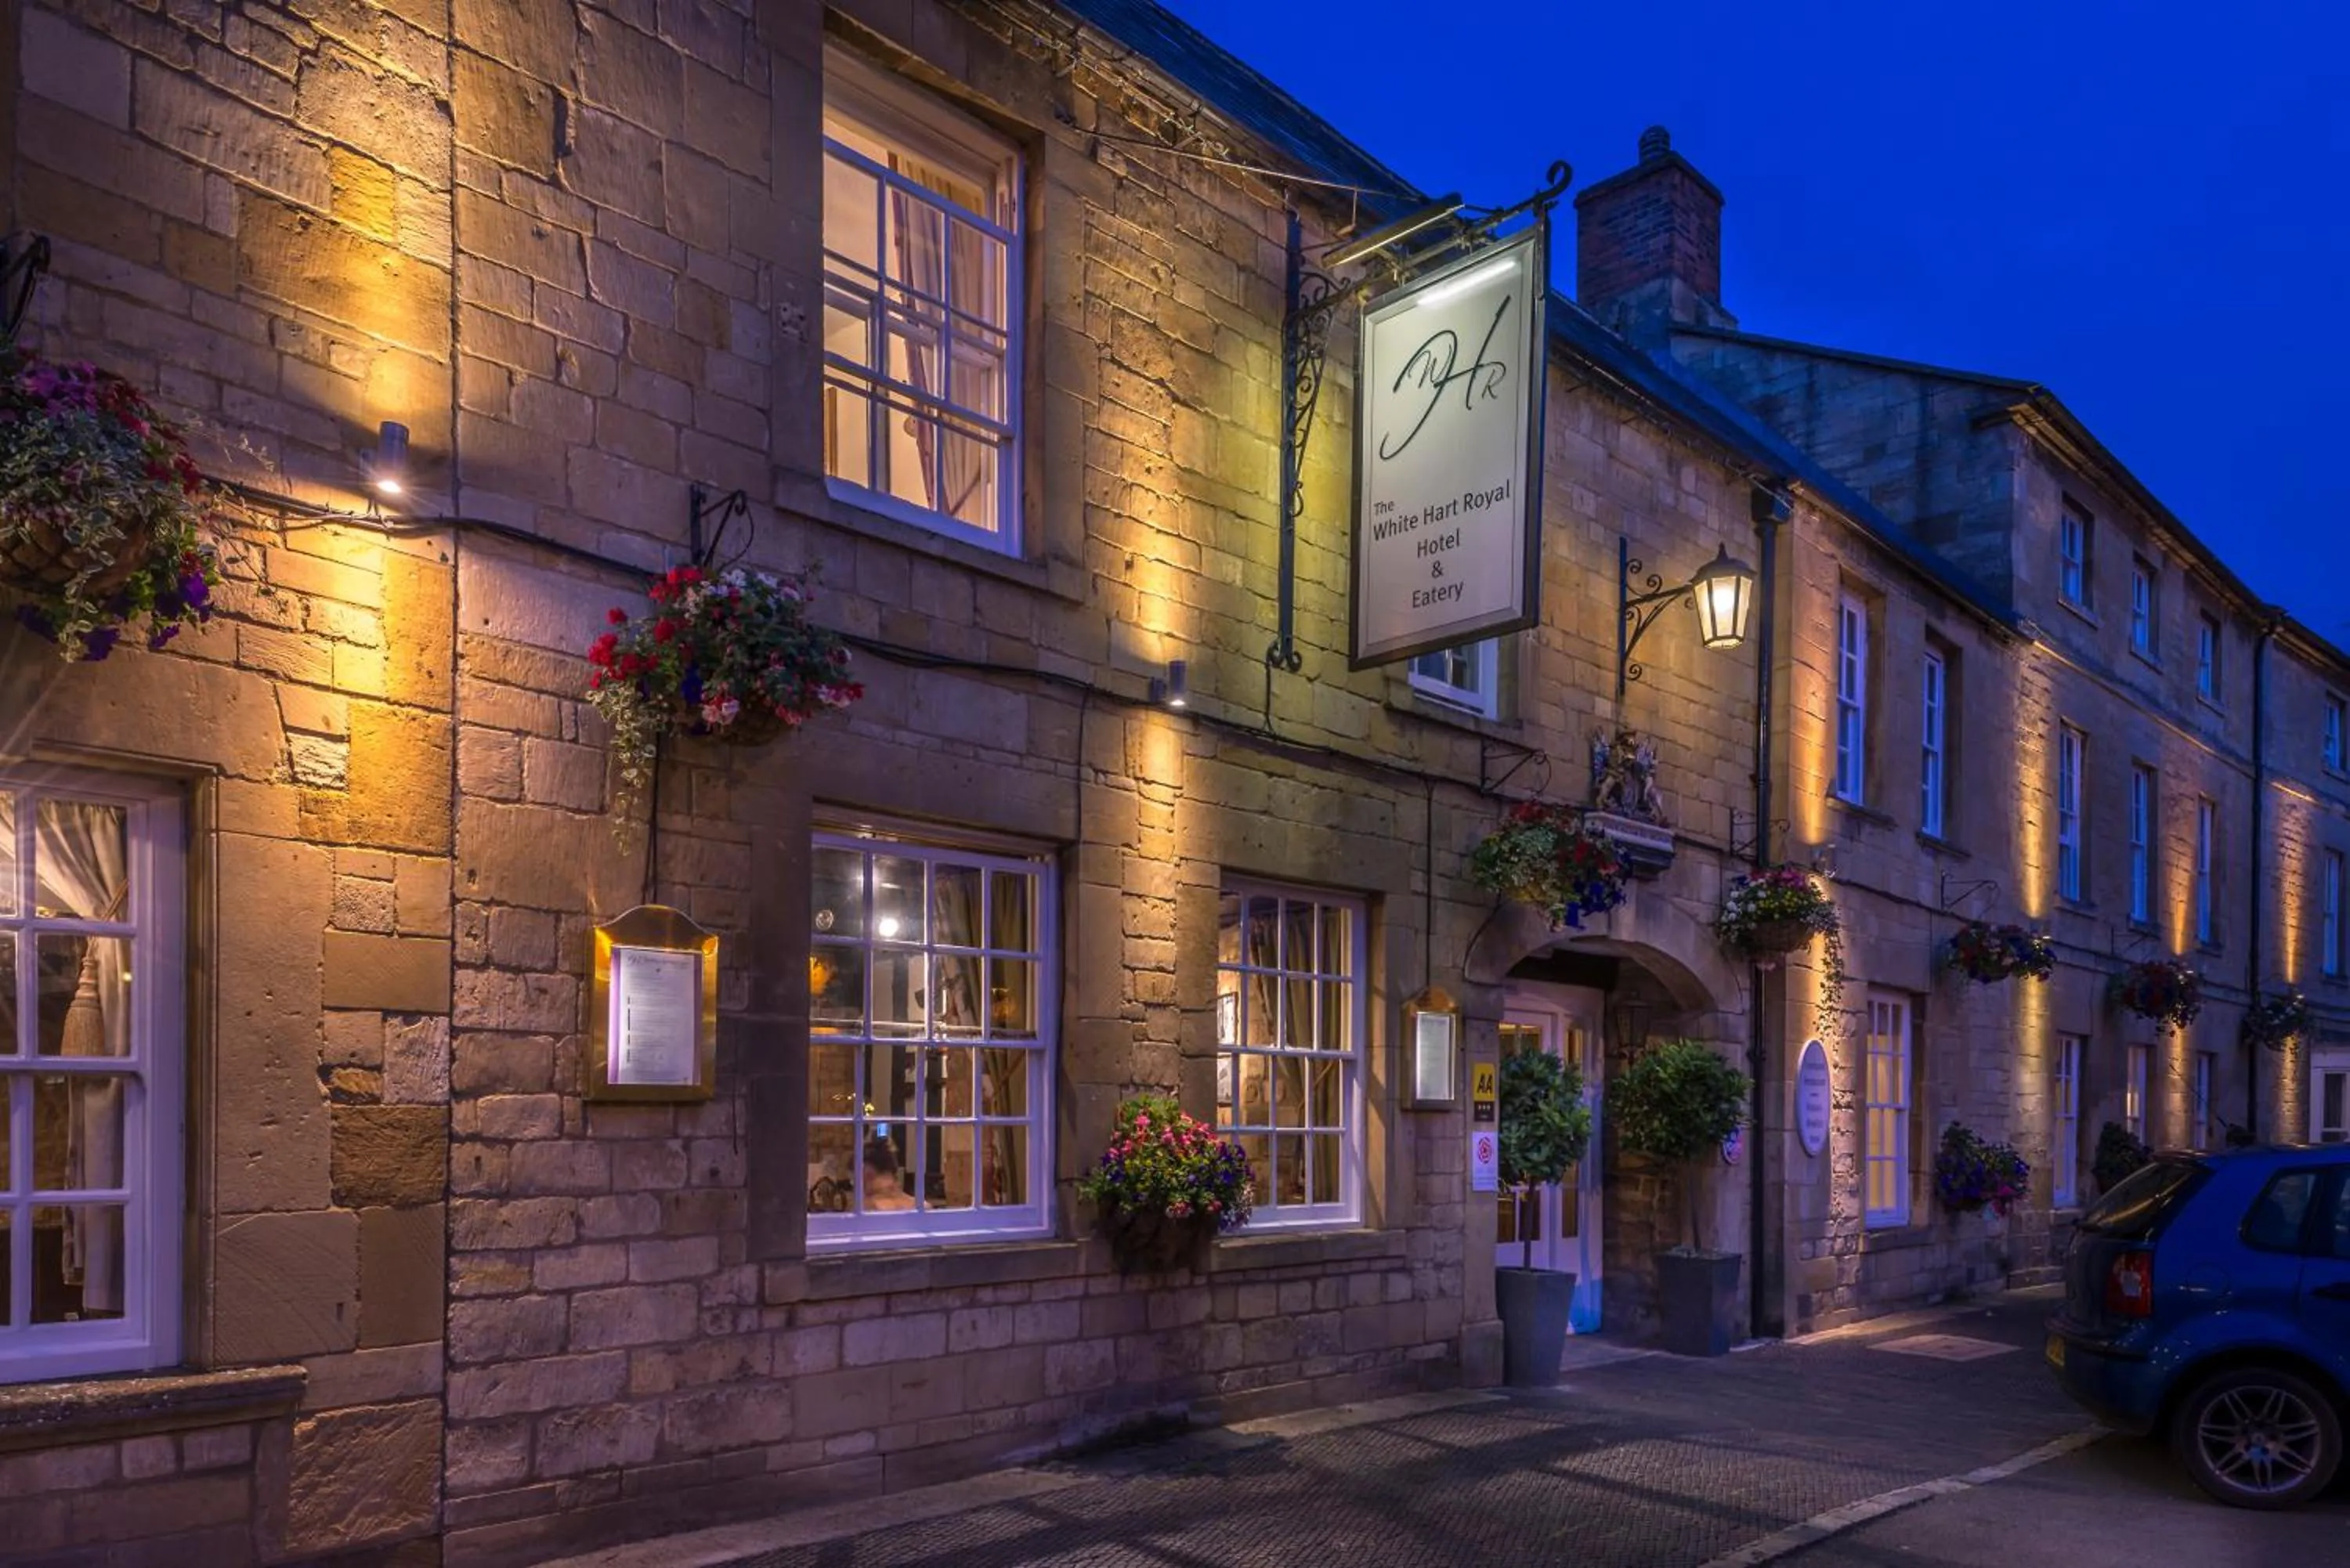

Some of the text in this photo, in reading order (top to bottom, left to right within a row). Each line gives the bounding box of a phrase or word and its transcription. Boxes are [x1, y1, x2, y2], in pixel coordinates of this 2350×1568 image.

[1373, 479, 1510, 542] White Hart Royal
[1374, 500, 1395, 516] The
[1417, 527, 1460, 558] Hotel
[1431, 560, 1444, 579] &
[1412, 581, 1464, 609] Eatery
[1476, 1072, 1493, 1094] AA
